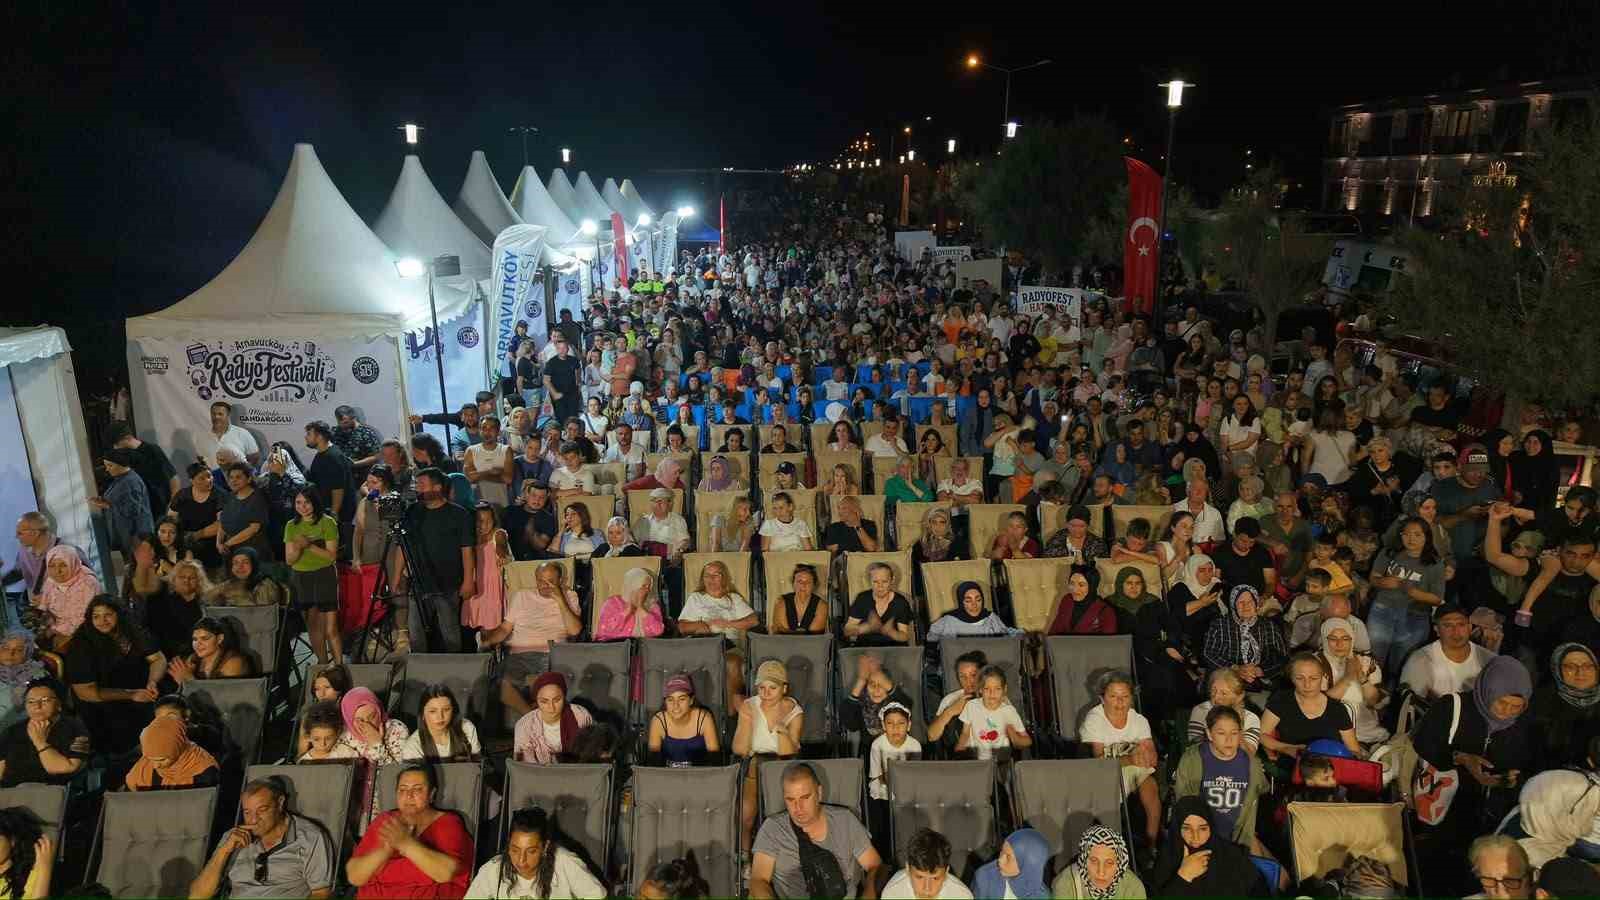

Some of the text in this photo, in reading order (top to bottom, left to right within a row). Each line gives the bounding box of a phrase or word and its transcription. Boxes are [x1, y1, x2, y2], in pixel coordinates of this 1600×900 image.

[497, 250, 519, 361] ARNAVUTKÖY
[1022, 290, 1074, 305] RADYOFEST
[204, 351, 263, 399] Radyo
[253, 351, 326, 391] Festivali
[1207, 787, 1241, 808] 50
